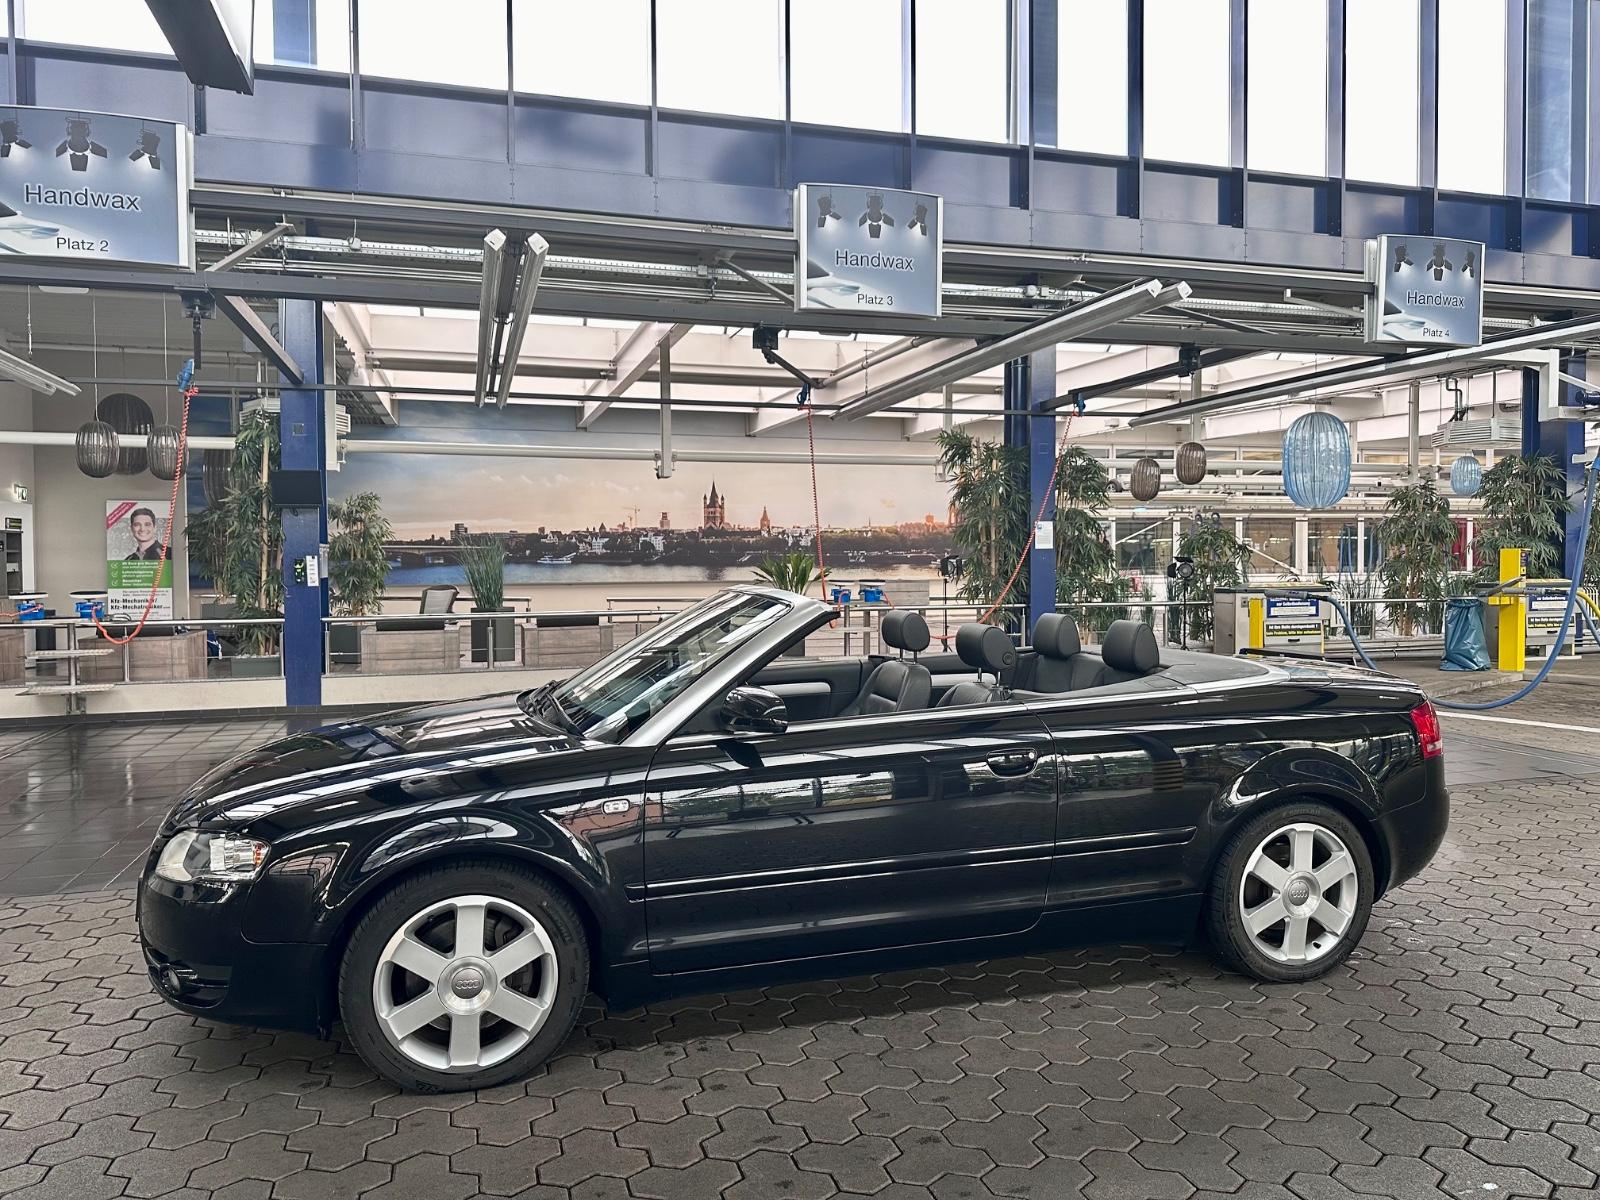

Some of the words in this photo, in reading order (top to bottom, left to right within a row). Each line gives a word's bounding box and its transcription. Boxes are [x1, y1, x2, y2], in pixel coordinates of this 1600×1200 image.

[24, 183, 141, 212] Handwax
[56, 236, 95, 252] Platz
[98, 239, 109, 252] 2
[835, 250, 914, 271] Handwax
[857, 293, 884, 305] Platz
[886, 295, 894, 306] 3
[1406, 291, 1465, 308] Handwax
[1423, 328, 1443, 337] Platz
[1445, 329, 1450, 337] 4
